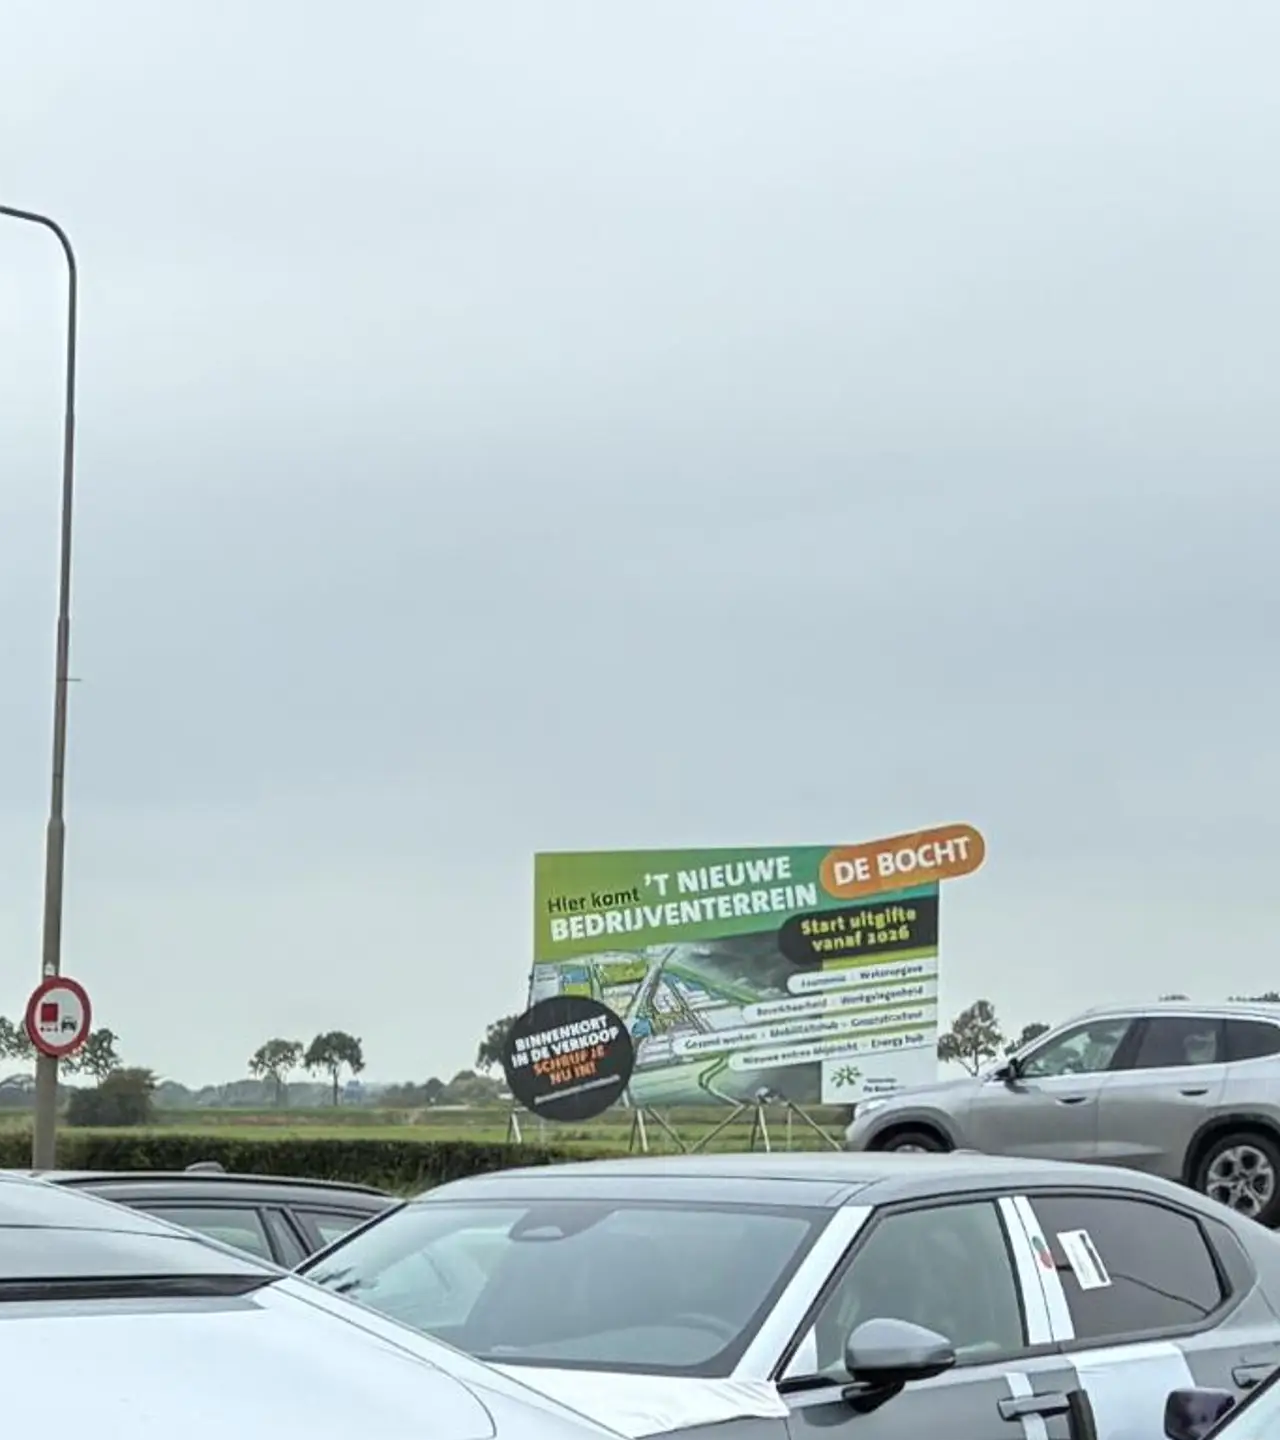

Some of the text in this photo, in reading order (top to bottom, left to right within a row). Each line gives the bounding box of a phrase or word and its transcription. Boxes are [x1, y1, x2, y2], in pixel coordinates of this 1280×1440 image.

[833, 836, 972, 886] DE BOCHT
[548, 895, 586, 914] Hier
[591, 887, 640, 909] komt
[677, 856, 792, 894] NIEUWE
[550, 882, 818, 942] BEDRIJVENTERREIN
[801, 907, 916, 936] Start uitgifte
[812, 926, 910, 952] vanaf 2026
[511, 1026, 620, 1068] IN DE VERKOOP
[515, 1015, 607, 1052] BINNENKORT
